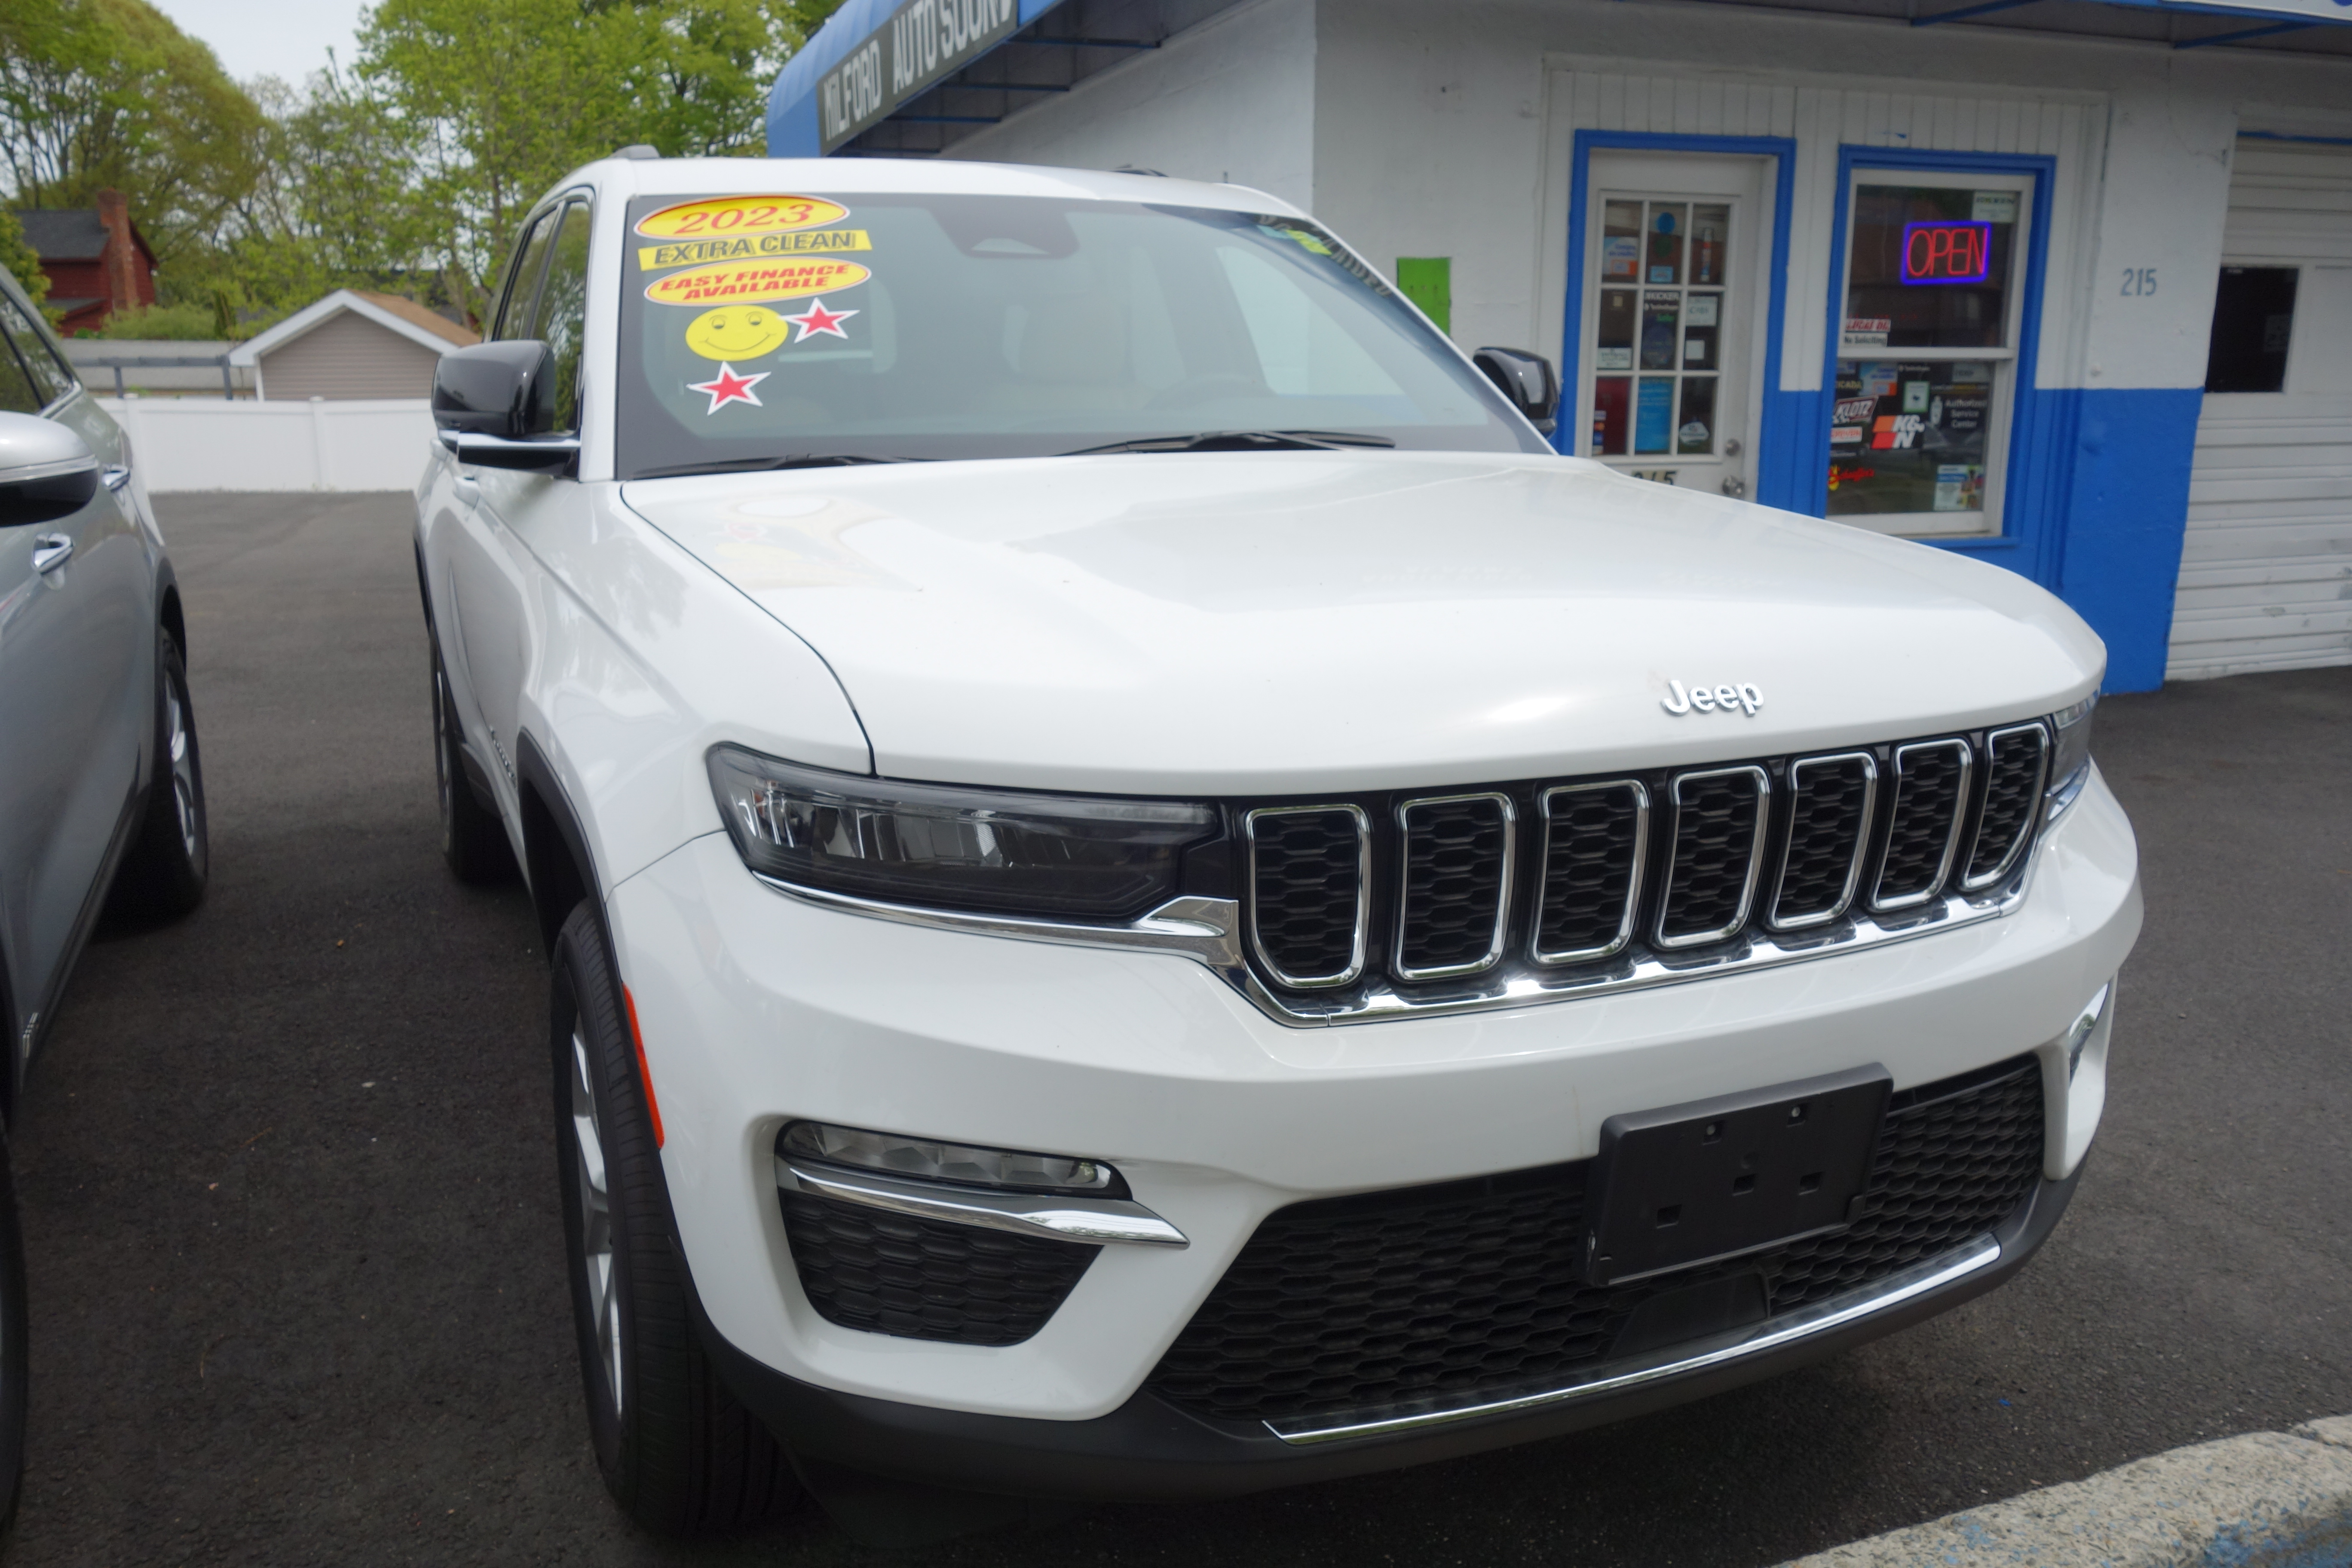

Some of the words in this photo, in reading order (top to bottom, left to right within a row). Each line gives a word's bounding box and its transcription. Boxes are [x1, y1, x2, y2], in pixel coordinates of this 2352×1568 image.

[823, 39, 882, 141] MILFORD
[674, 204, 814, 234] 2023
[654, 239, 755, 265] EXTRA
[760, 231, 855, 254] CLEAN
[1906, 228, 1988, 276] OPEN
[660, 273, 727, 292] EASY
[734, 263, 850, 282] FINANCE
[683, 276, 830, 300] AVAILABLE
[2120, 268, 2157, 296] 215
[1660, 680, 1764, 717] Jeep
